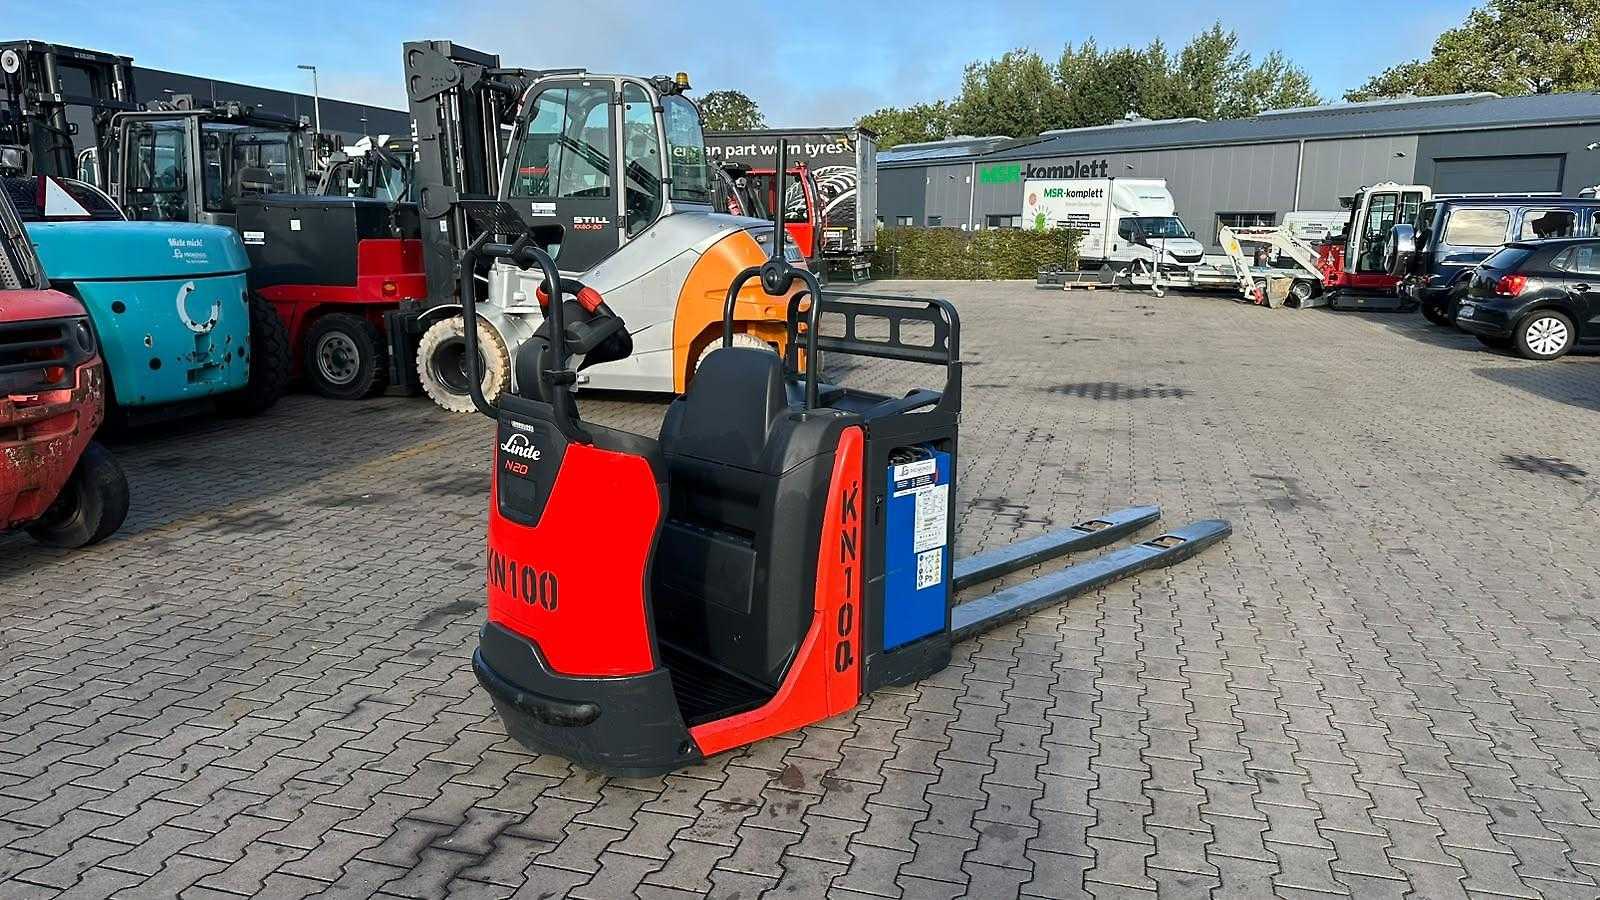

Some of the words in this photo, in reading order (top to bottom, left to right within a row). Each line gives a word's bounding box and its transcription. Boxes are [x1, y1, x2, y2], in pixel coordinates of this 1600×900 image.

[725, 144, 757, 158] part
[805, 143, 843, 157] tyres
[1044, 188, 1103, 199] MSR-komplett
[573, 216, 610, 224] STILL
[500, 433, 541, 460] Linde
[505, 460, 529, 475] N20
[487, 547, 559, 611] KN100
